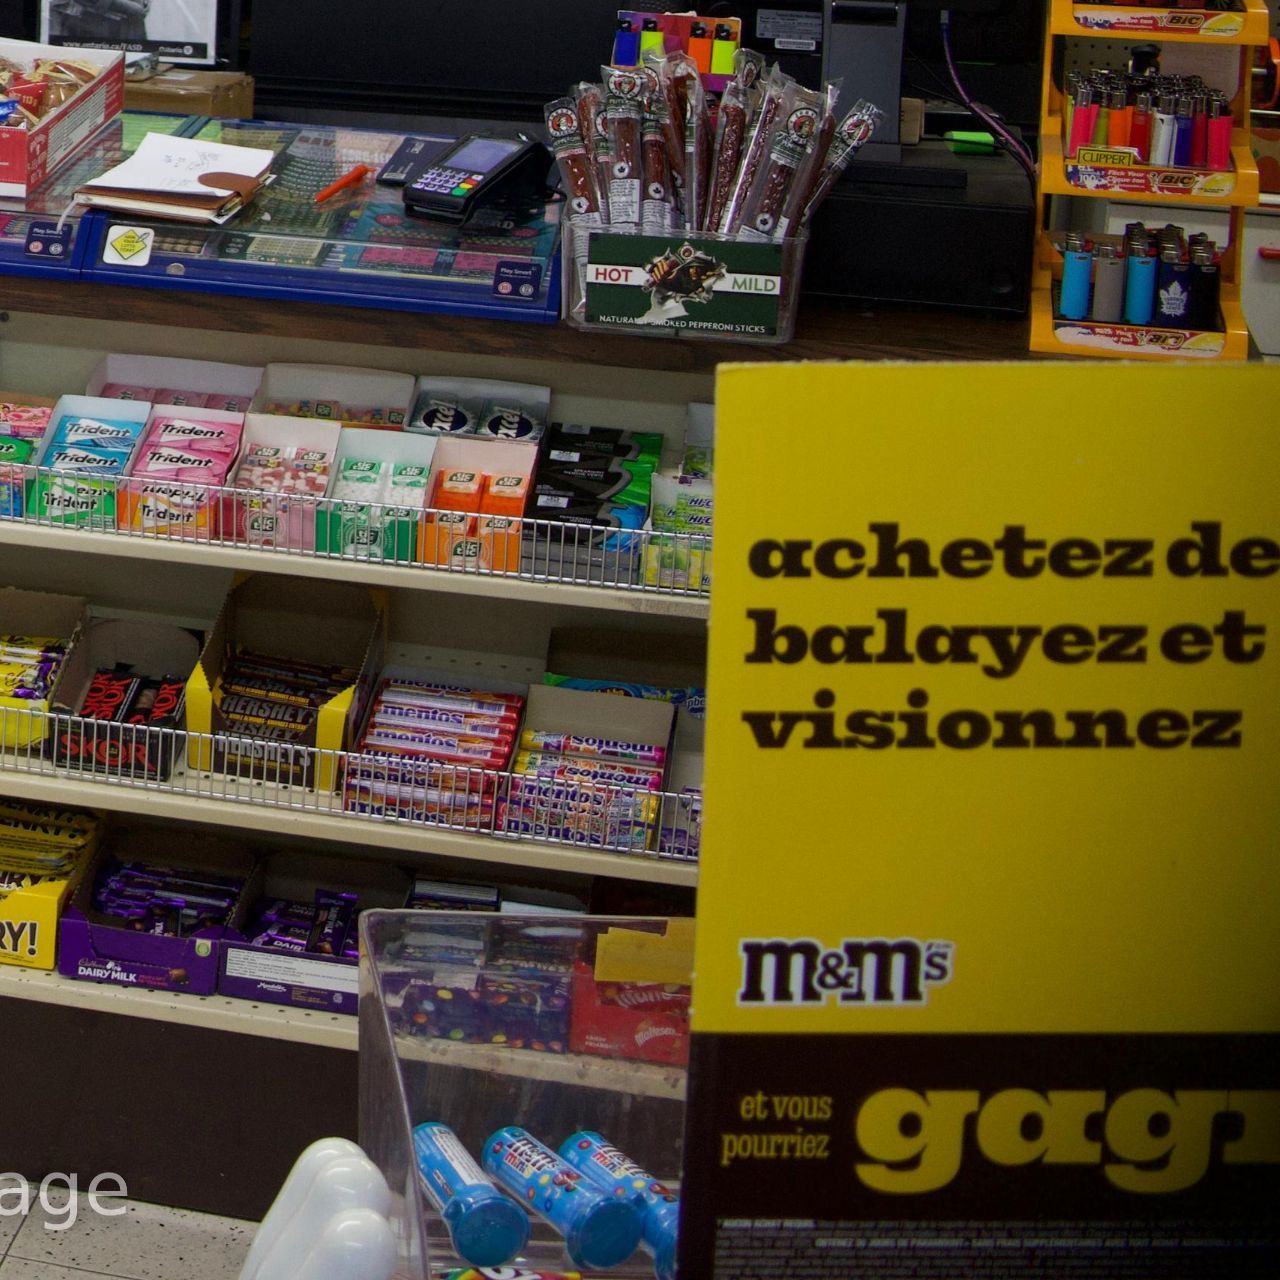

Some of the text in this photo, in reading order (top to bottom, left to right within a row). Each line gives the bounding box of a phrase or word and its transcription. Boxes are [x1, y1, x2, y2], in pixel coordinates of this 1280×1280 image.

[1082, 151, 1131, 165] CLIPPER
[595, 268, 633, 282] HOT
[731, 277, 776, 292] MILD
[688, 321, 765, 333] PEPPERONI STICKS
[747, 522, 1152, 580] achetez
[745, 608, 1267, 679] balayez et
[382, 705, 464, 724] mentos
[741, 689, 1243, 750] visionnez
[78, 966, 137, 983] DAIRY MILK
[740, 1092, 833, 1122] et vous
[722, 1125, 830, 1165] pourriez
